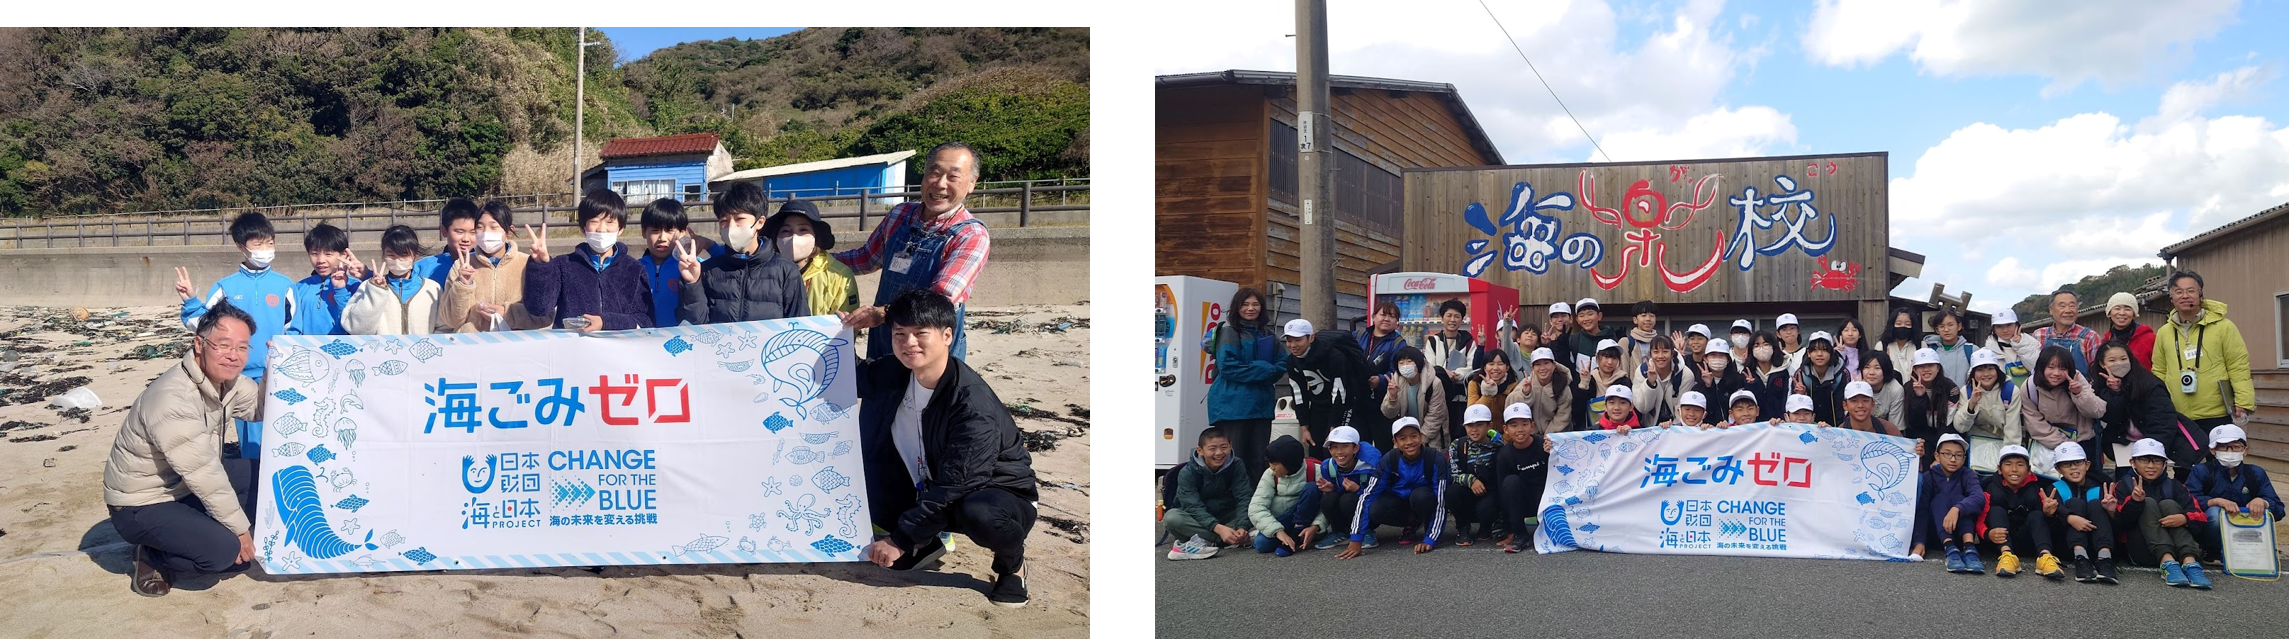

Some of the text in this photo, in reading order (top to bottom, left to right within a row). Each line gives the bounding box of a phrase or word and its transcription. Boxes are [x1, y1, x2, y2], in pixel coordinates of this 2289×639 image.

[423, 373, 691, 434] 海ごみゼロ
[500, 451, 540, 471] 日本
[547, 449, 657, 471] CHANGE
[1640, 452, 1812, 489] 海ごみゼロ
[501, 473, 541, 493] 財団
[598, 473, 657, 486] FOR THE
[599, 489, 657, 511] BLUE
[1686, 499, 1712, 512] 日本
[1717, 500, 1786, 516] CHANGE
[492, 519, 541, 529] PROJECT
[549, 513, 658, 527] 海の未来を変える挑戦
[1748, 516, 1786, 527] FOR THE
[1749, 527, 1787, 543] BLUE
[1716, 541, 1787, 551] 海の未来を変える挑戦
